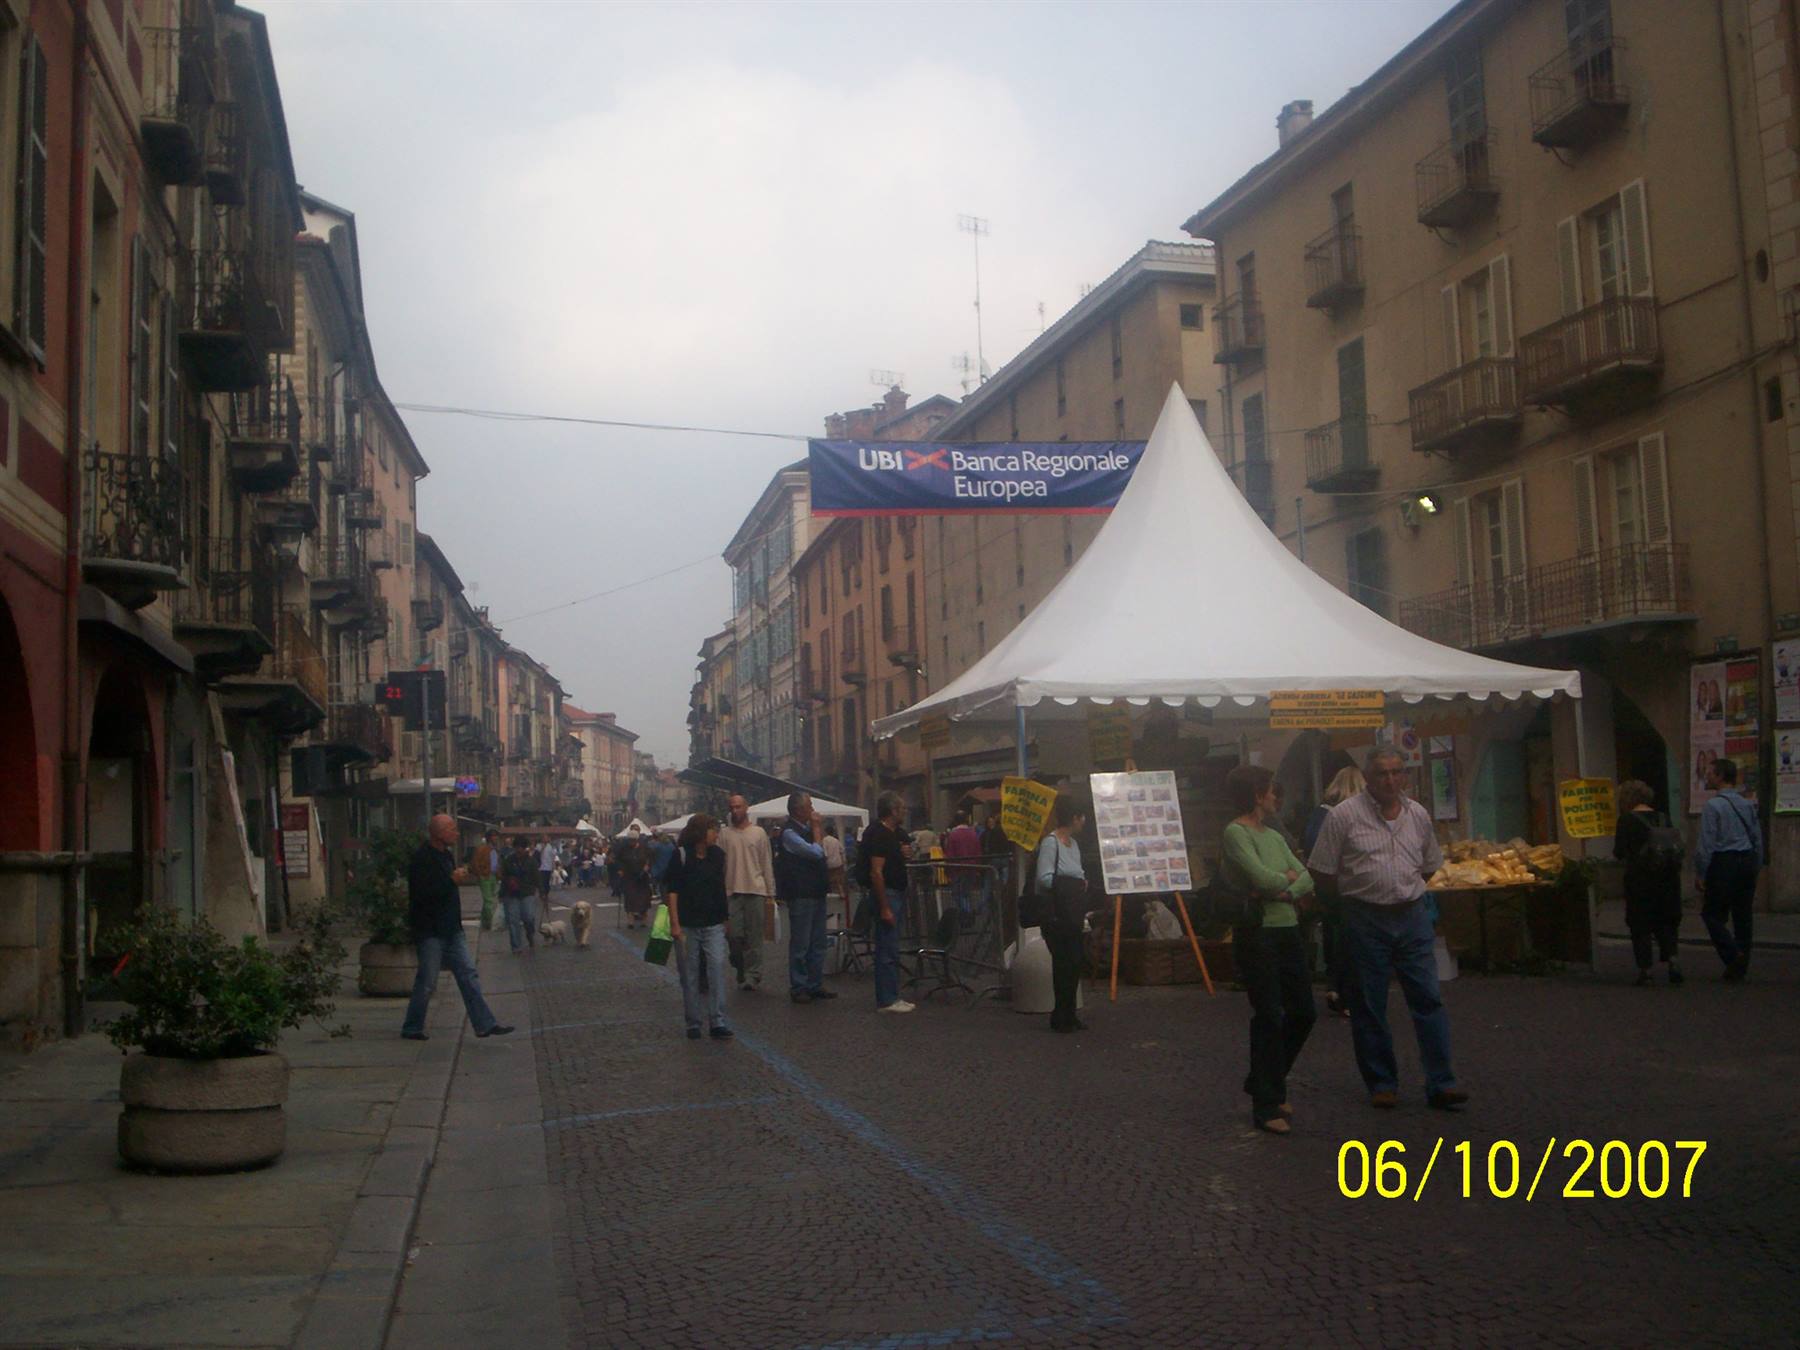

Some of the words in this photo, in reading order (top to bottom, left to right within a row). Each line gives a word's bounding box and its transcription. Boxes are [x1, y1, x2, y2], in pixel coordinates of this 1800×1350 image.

[859, 448, 903, 471] UBI
[952, 450, 1019, 472] Banca
[1022, 450, 1130, 478] Regionale
[955, 475, 1048, 502] Europea
[1005, 786, 1048, 807] FARINA
[1562, 787, 1609, 798] FARINA
[1004, 803, 1042, 824] POLENTA
[1564, 802, 1611, 814] POLENTA
